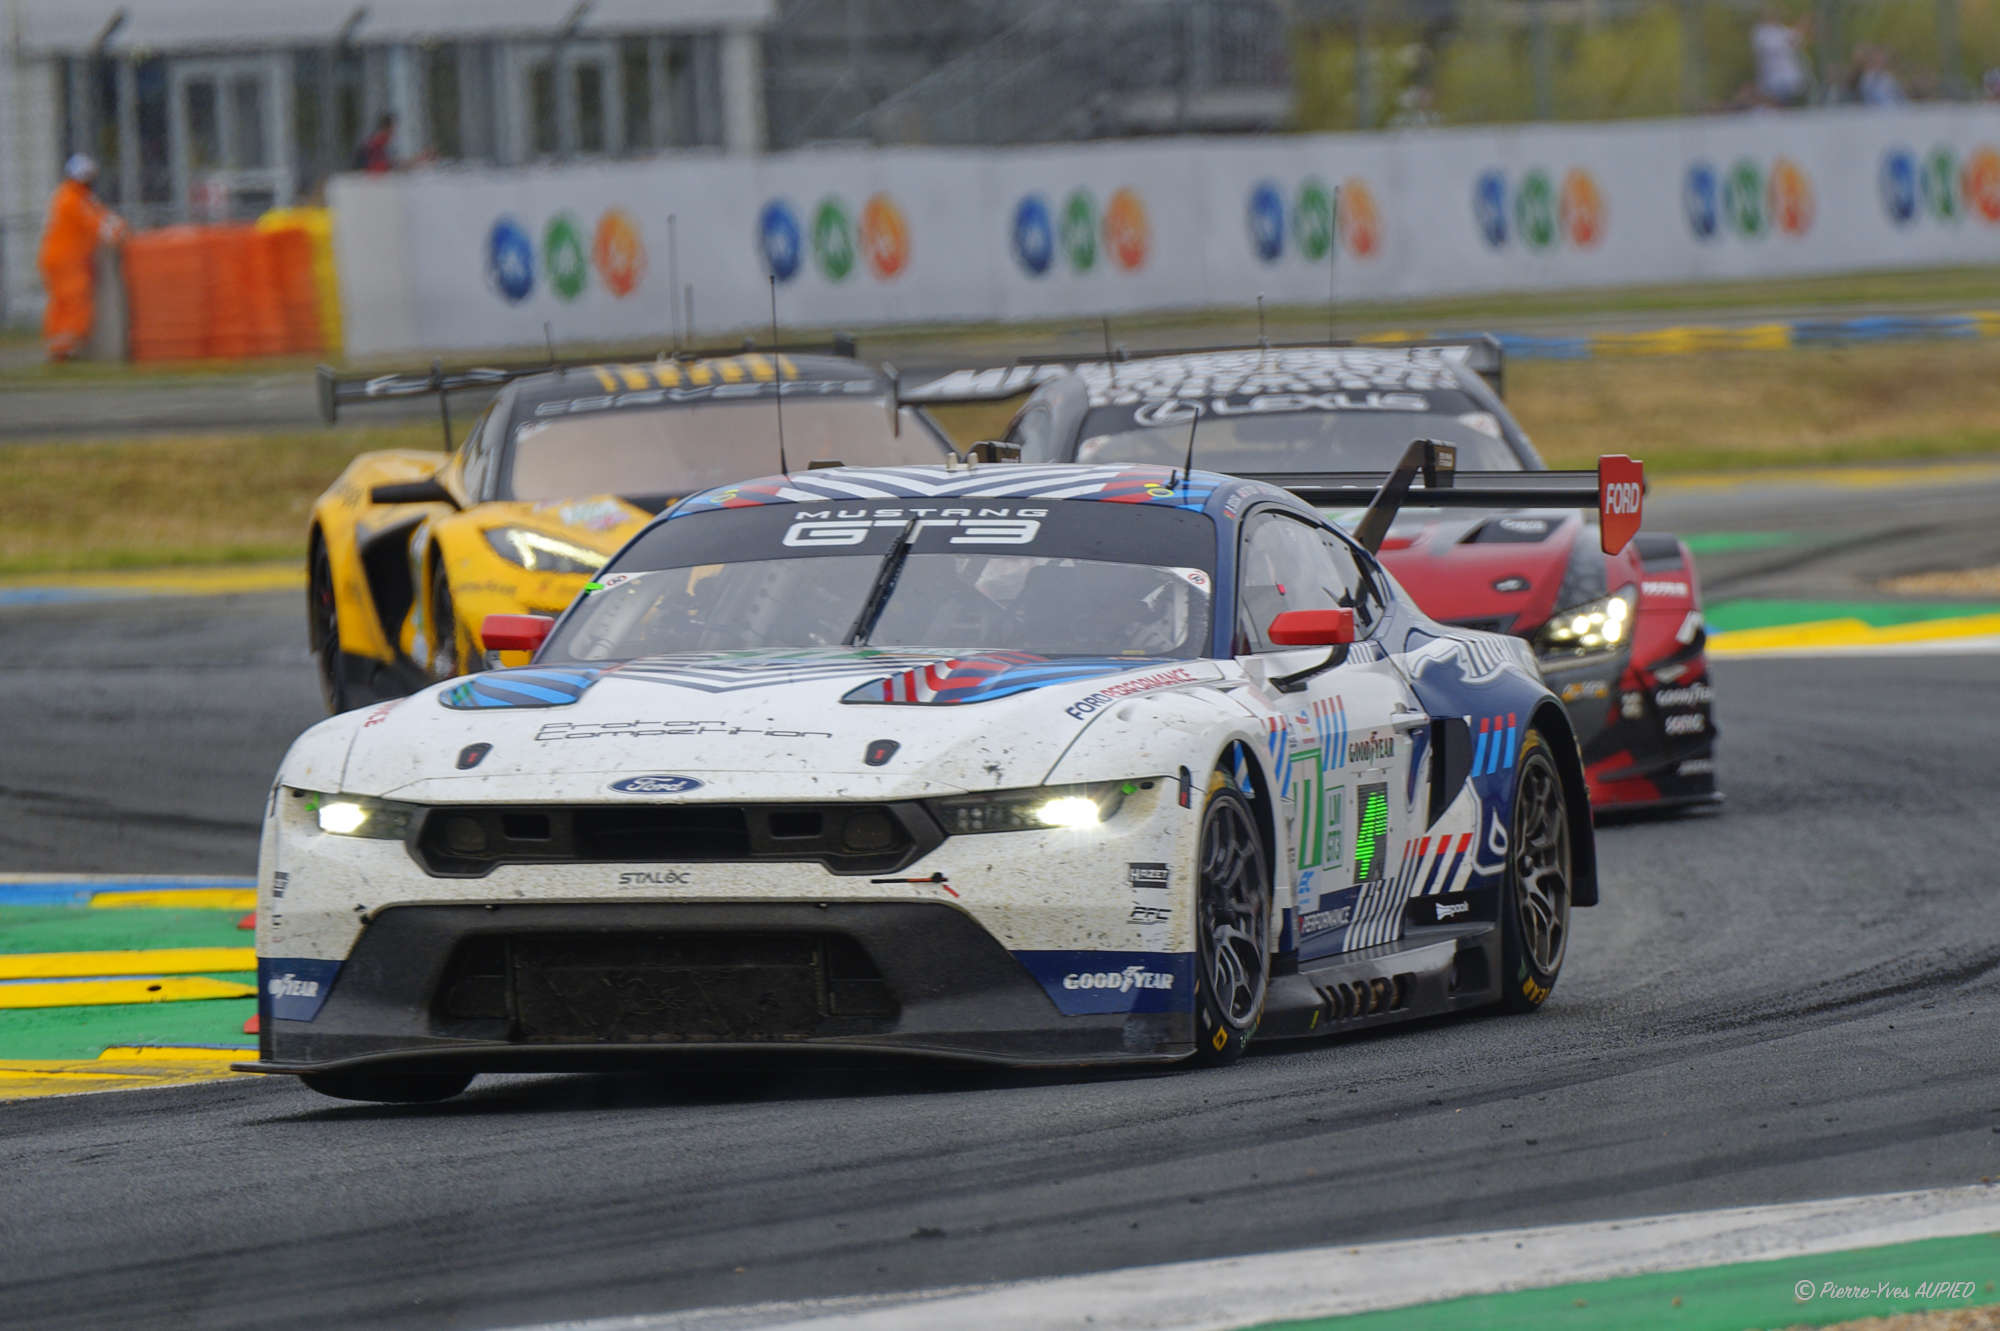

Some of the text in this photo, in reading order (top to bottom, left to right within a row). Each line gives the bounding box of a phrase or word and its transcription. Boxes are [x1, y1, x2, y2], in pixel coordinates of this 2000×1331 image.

[1211, 393, 1430, 415] LEXUS
[1604, 482, 1640, 514] FORD
[795, 508, 1049, 520] MUSTANG
[782, 519, 1041, 547] GT3
[1065, 668, 1198, 721] FORD PERFORMANCE
[534, 727, 833, 741] Competition
[540, 720, 726, 731] Proton
[1348, 731, 1395, 766] GOODYEAR
[625, 776, 688, 793] Ford
[1062, 965, 1175, 993] GOODYEAR
